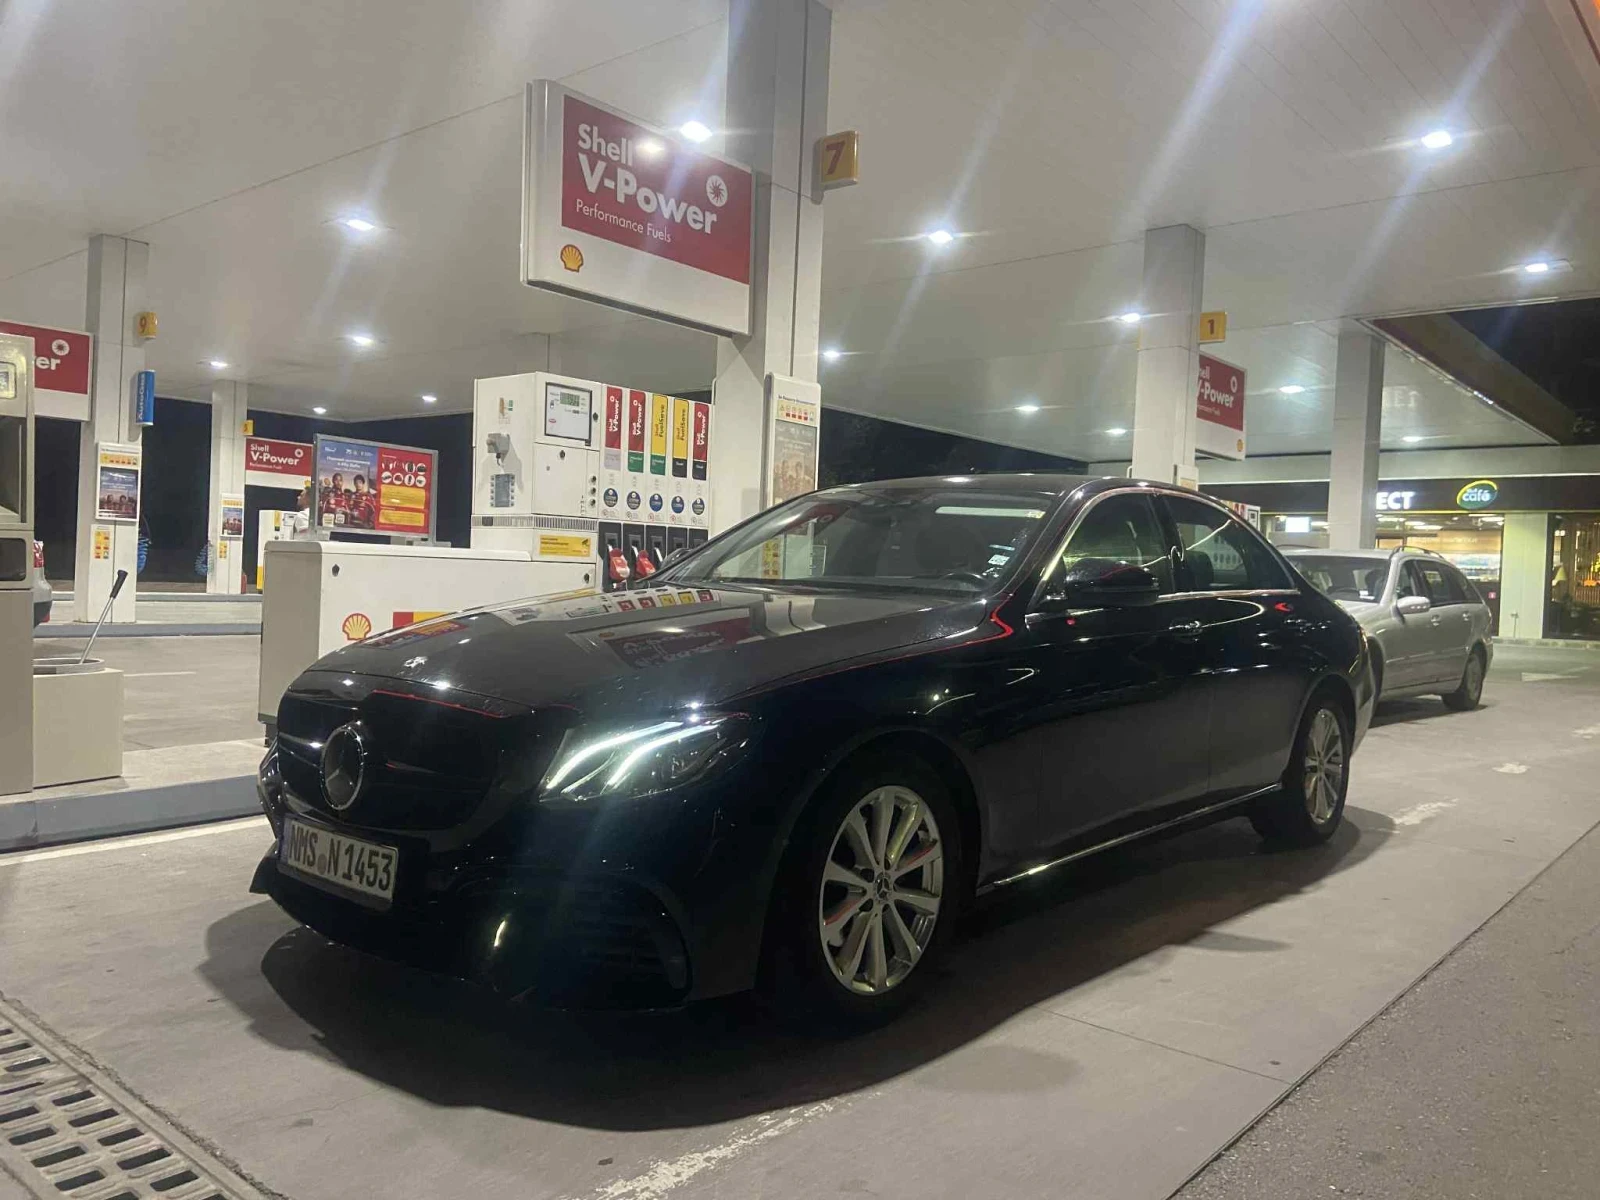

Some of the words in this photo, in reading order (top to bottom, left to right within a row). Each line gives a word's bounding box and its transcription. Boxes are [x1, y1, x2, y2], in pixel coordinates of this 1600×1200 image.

[577, 123, 633, 166] Shell
[824, 141, 845, 176] 7
[577, 153, 718, 234] V-Power
[576, 199, 644, 236] Performance
[646, 223, 672, 243] Fuels
[1207, 319, 1215, 335] 1
[612, 398, 620, 432] V-Power
[250, 443, 270, 453] Shell
[250, 451, 300, 466] V-Power
[1462, 489, 1491, 502] café
[289, 825, 318, 867] NMS
[327, 838, 341, 876] N
[342, 843, 393, 891] 1453
